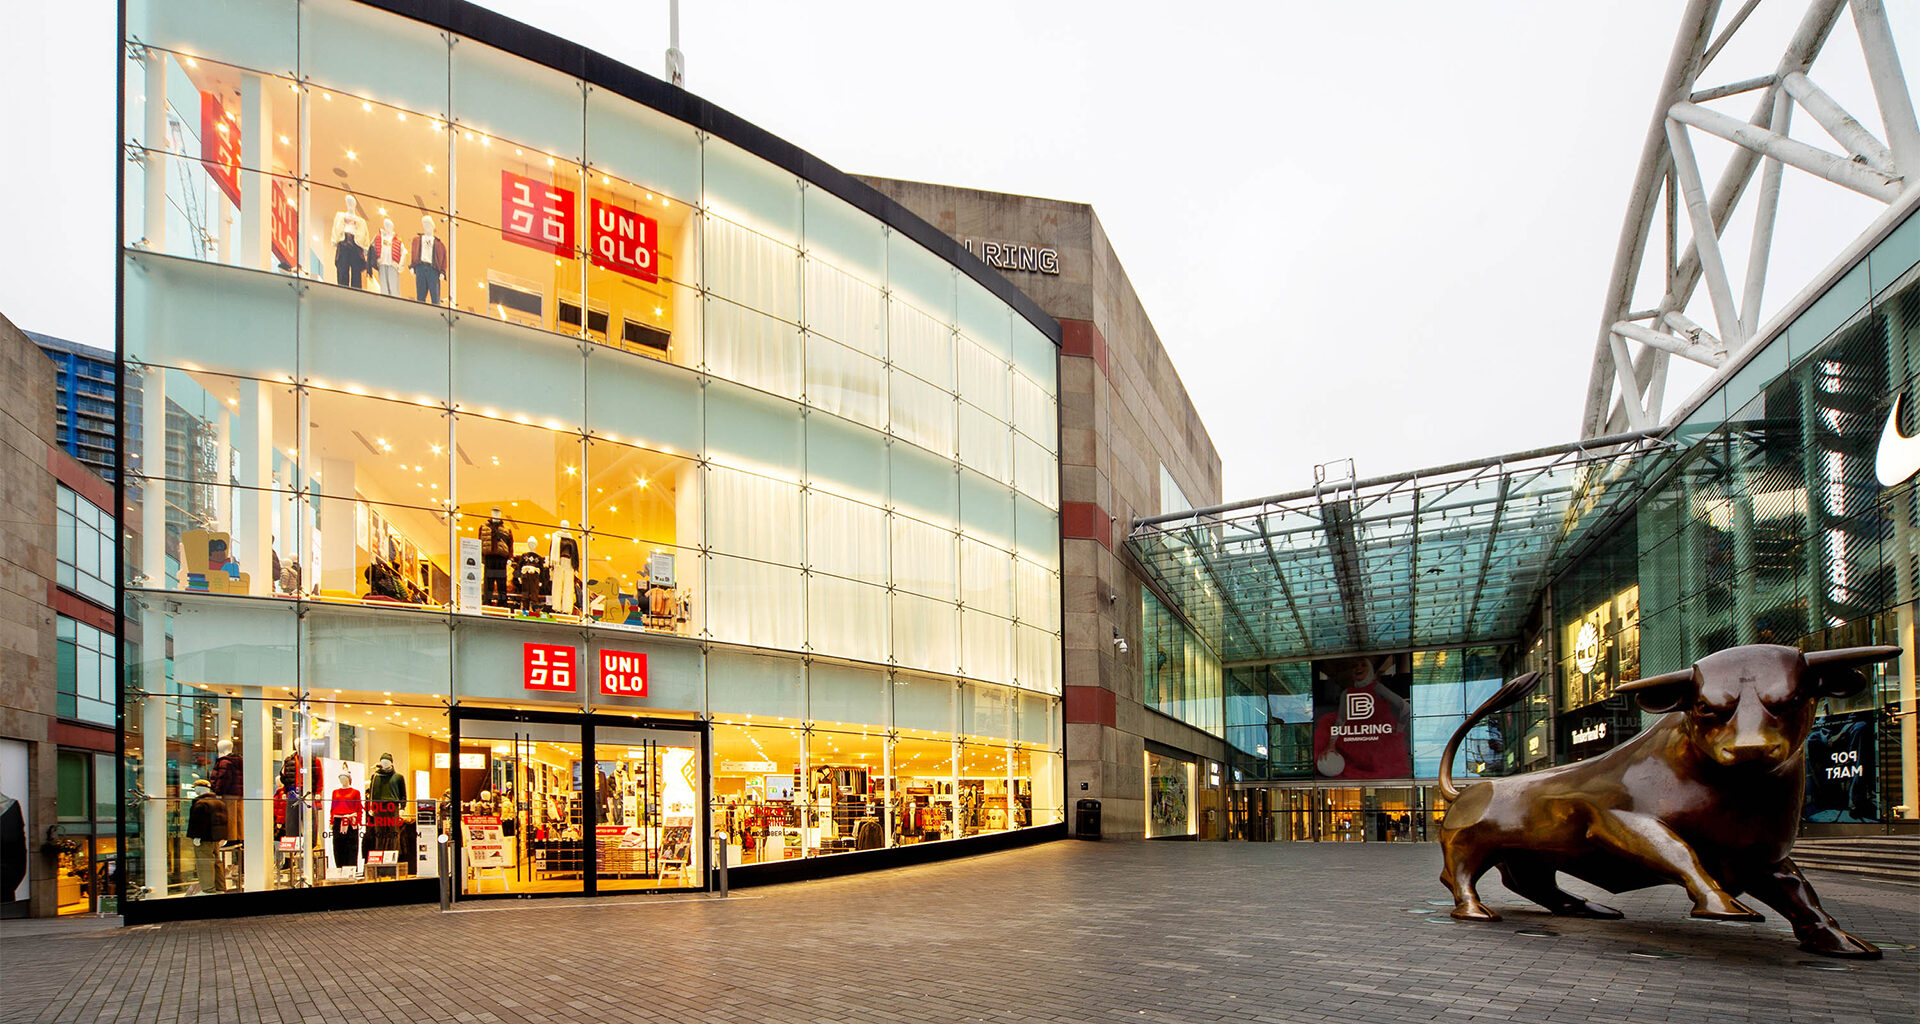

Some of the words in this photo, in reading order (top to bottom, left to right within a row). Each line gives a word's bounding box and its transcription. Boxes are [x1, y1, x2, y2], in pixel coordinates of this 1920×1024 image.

[599, 208, 645, 243] UNI
[599, 235, 650, 268] QLO
[604, 655, 640, 674] UNI
[605, 674, 643, 692] QLO
[1330, 723, 1393, 736] BULLRING
